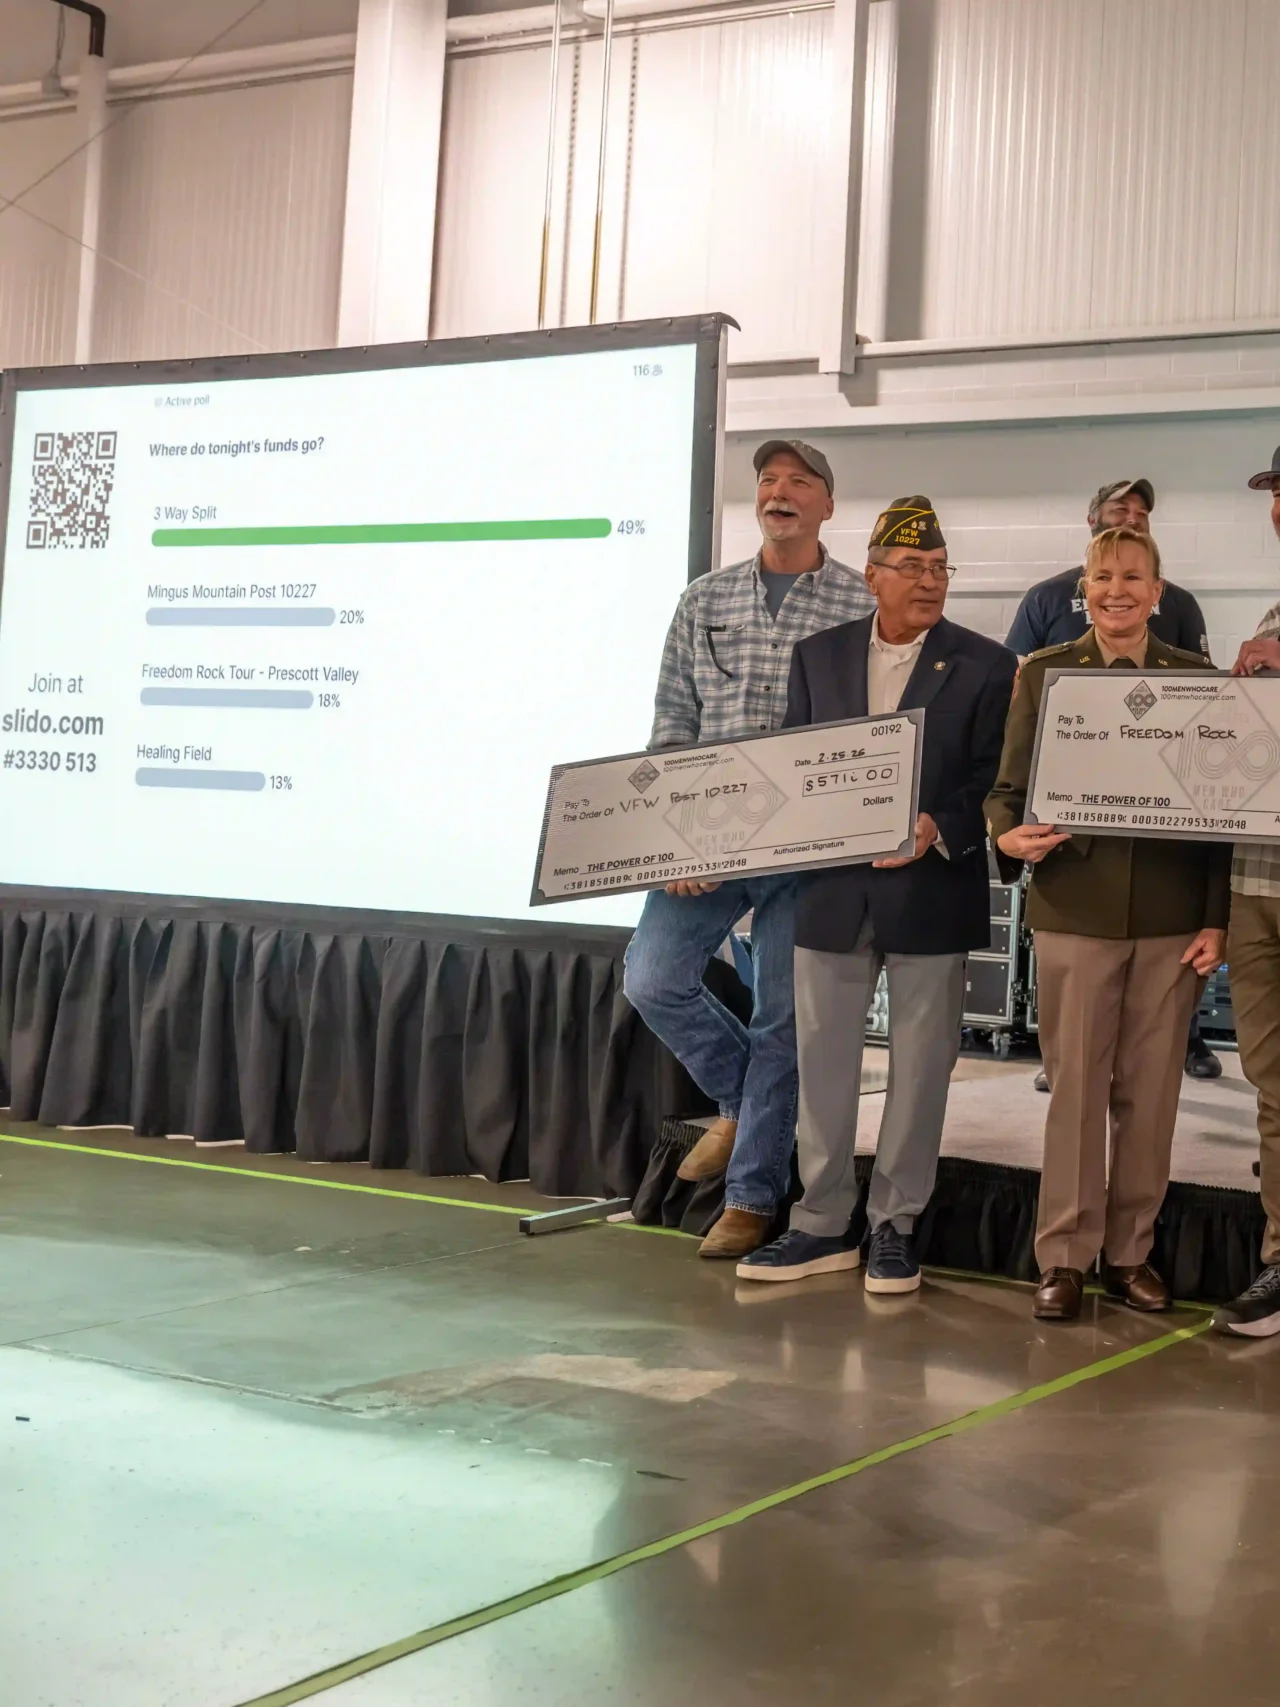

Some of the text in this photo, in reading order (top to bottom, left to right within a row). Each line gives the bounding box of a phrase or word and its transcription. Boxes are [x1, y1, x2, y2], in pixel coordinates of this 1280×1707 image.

[632, 364, 650, 377] 116
[165, 395, 210, 408] Active poll
[149, 436, 325, 458] Where do tonight's funds go?
[153, 505, 217, 523] 3 Way Split
[616, 519, 646, 536] 49%
[900, 528, 919, 537] VFW
[894, 535, 920, 546] 10227
[147, 584, 317, 602] Mingus Mountain Post 10227
[339, 610, 365, 625] 20%
[141, 663, 193, 679] Freedom
[196, 665, 225, 680] Rock
[229, 665, 255, 680] Tour
[268, 666, 319, 681] Prescott
[323, 666, 359, 685] Valley
[28, 672, 83, 694] Join at
[318, 693, 340, 708] 18%
[1160, 694, 1236, 702] 100menwhocareyc.com
[2, 708, 104, 735] slido.com
[1058, 715, 1085, 726] Pay To
[871, 723, 903, 737] 00192
[1056, 730, 1109, 740] The Order Of
[1120, 725, 1184, 739] FREEDOM
[136, 744, 212, 763] Healing Field
[664, 753, 718, 766] 100MENWHOCARE
[3, 750, 97, 773] #3330 513
[794, 759, 811, 767] Date
[269, 775, 293, 791] 13%
[619, 796, 660, 813] VFW
[705, 783, 748, 799] 10227
[863, 796, 894, 806] Dollars
[1047, 791, 1073, 802] Memo
[1081, 794, 1171, 807] THE POWER OF 100
[564, 799, 590, 810] Pay To
[563, 807, 614, 822] The Order Of
[773, 840, 845, 856] Authorized Signature
[587, 852, 674, 872] THE POWER OF 100
[553, 866, 580, 877] Memo
